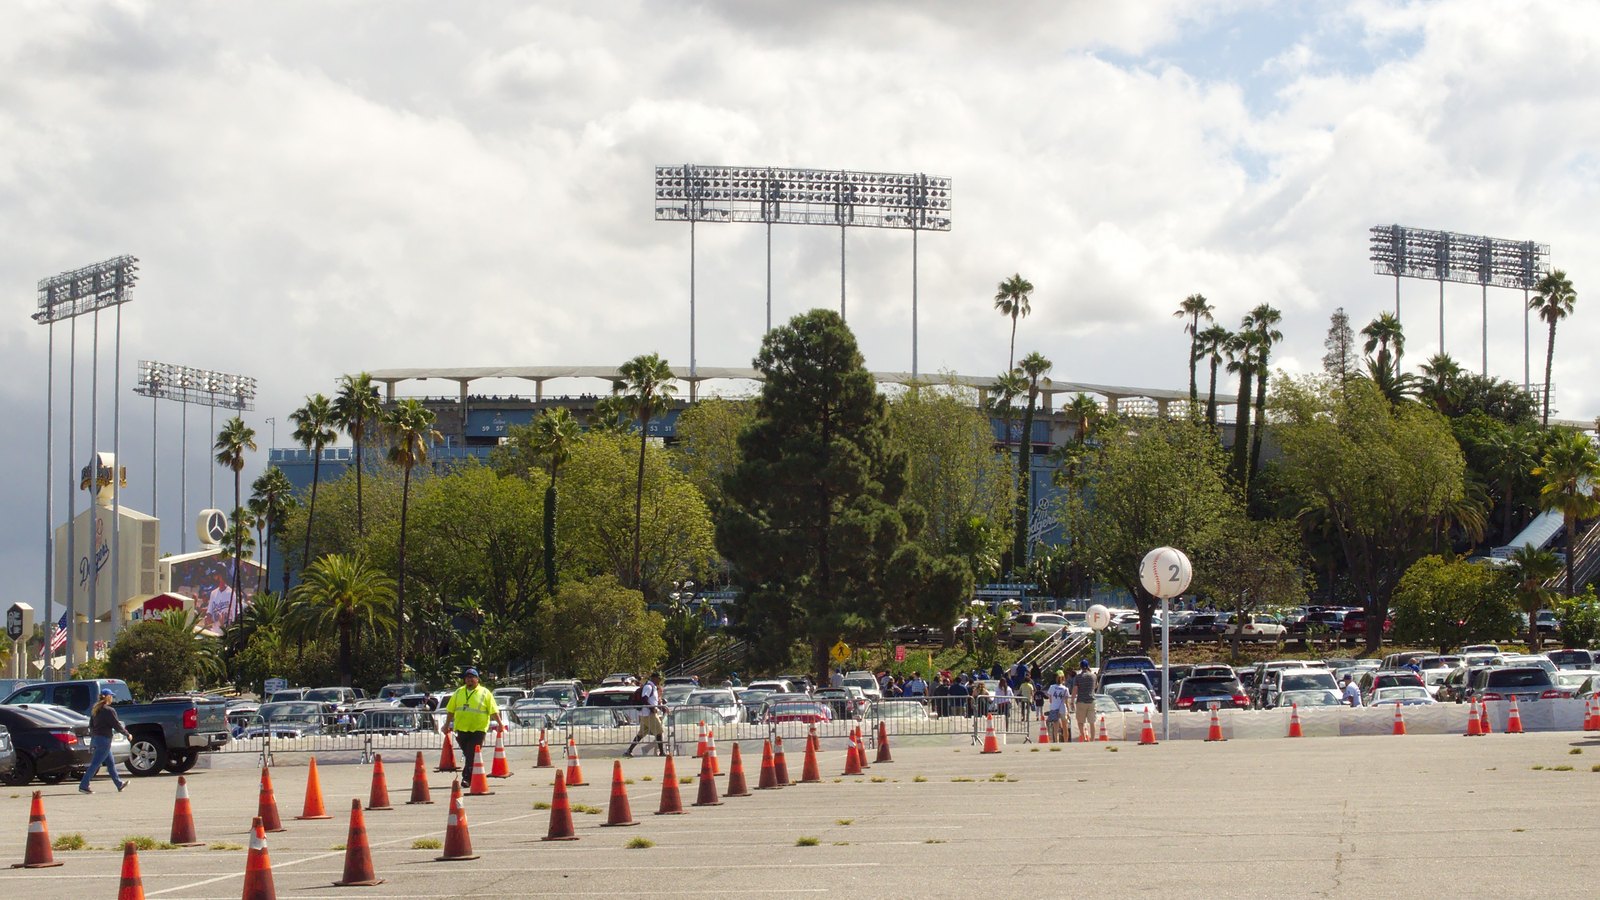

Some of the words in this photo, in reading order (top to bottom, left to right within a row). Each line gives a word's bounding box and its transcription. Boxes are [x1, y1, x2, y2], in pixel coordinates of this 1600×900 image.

[1168, 564, 1180, 582] 2
[1093, 612, 1101, 623] F
[1053, 691, 1064, 700] 44
